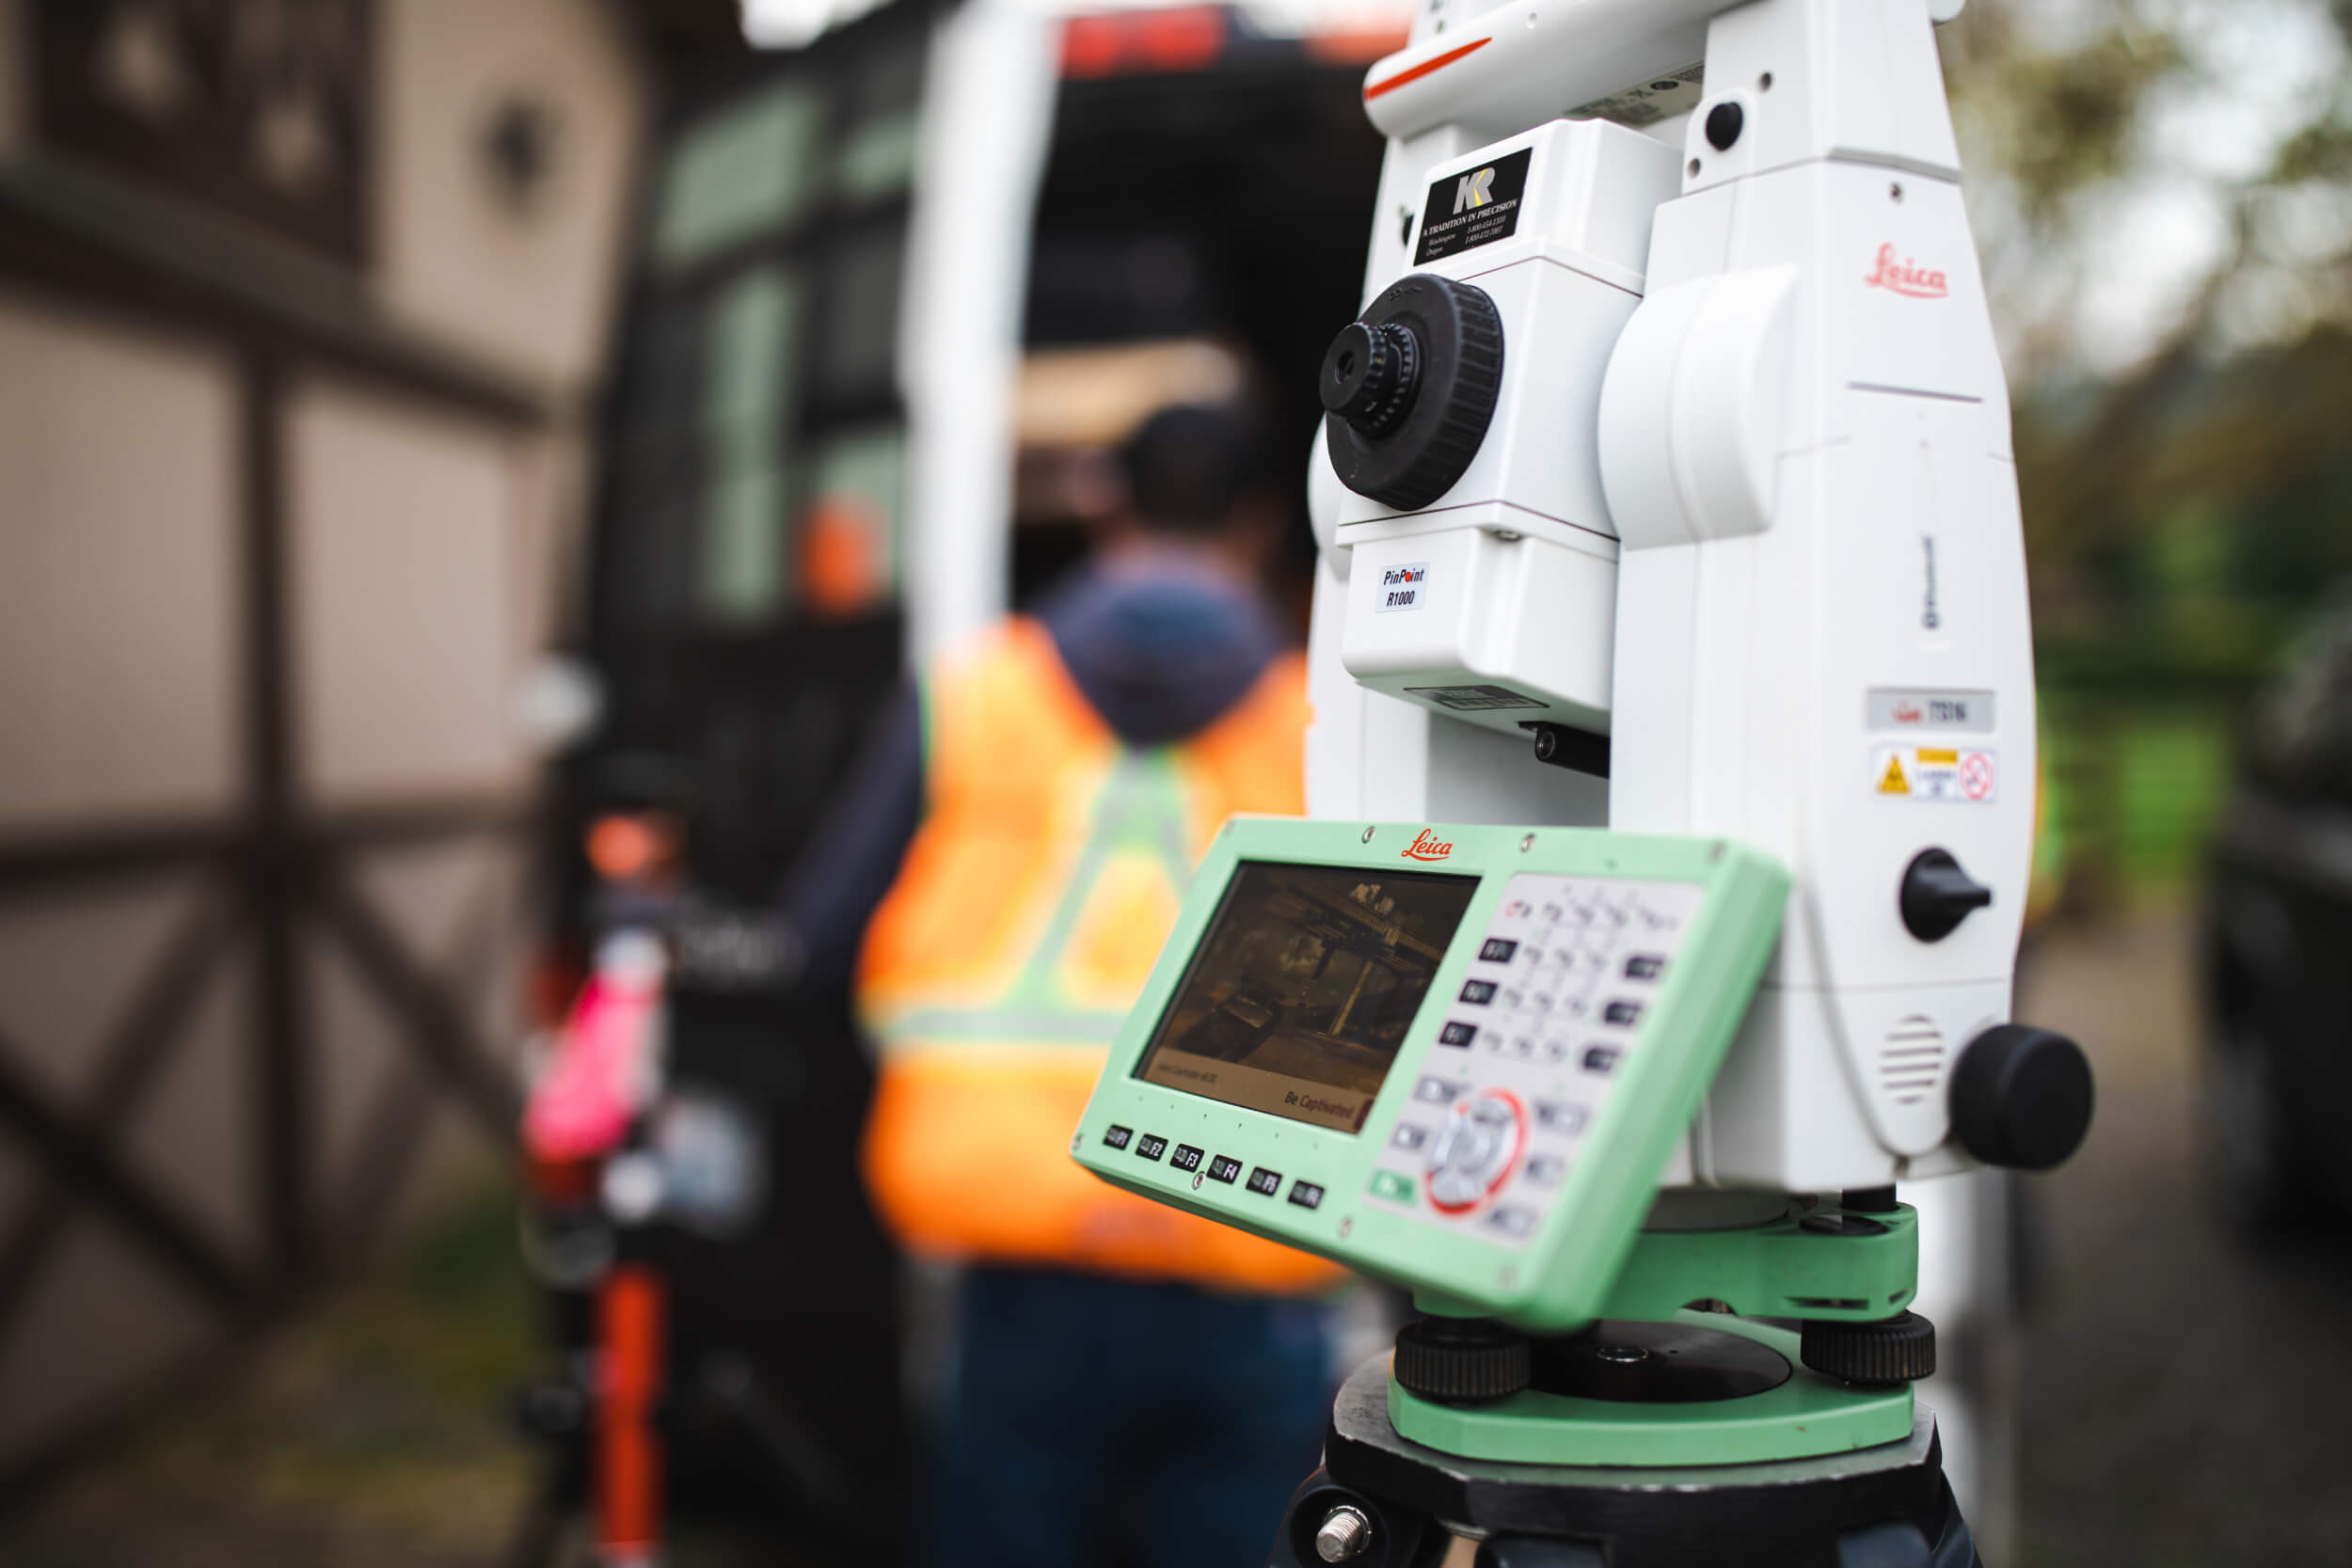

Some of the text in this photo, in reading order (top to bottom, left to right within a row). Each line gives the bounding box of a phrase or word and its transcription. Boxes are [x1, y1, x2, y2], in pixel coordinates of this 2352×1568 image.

[1453, 166, 1496, 215] KR
[1429, 215, 1468, 235] TRADITION
[1468, 213, 1477, 223] IN
[1477, 198, 1518, 219] PRECISION
[1863, 241, 1949, 300] Leica
[1383, 567, 1425, 585] PinPoint
[1386, 590, 1416, 607] R1000
[1401, 828, 1454, 862] Leica
[1284, 1090, 1299, 1105] Be
[1149, 1141, 1164, 1157] F2
[1185, 1152, 1200, 1167] F3
[1223, 1163, 1238, 1180] F4
